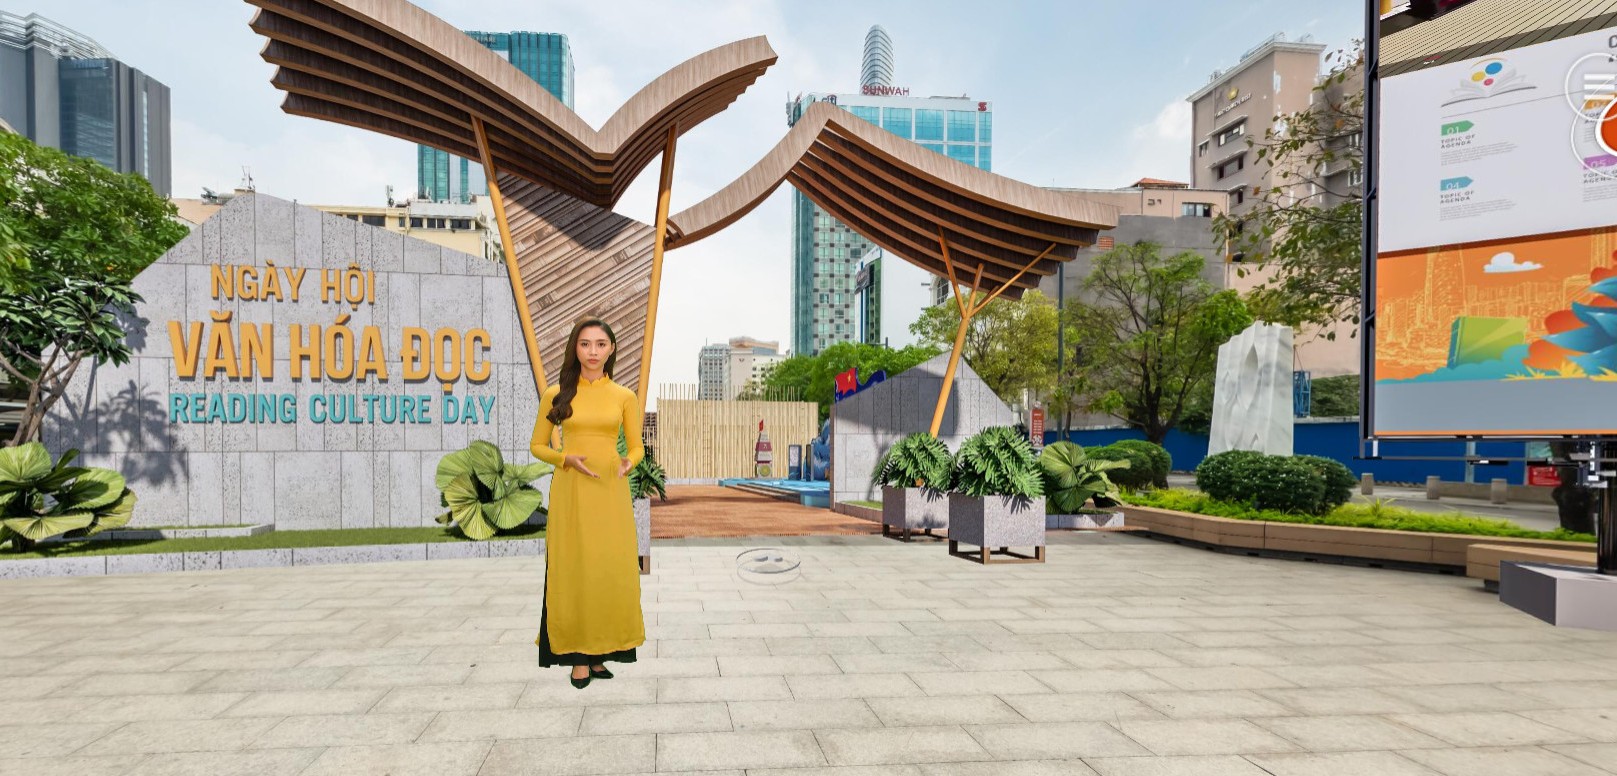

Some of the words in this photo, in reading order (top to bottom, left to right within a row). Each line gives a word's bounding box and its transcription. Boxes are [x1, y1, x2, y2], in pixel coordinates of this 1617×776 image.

[863, 84, 910, 96] SUNWAH
[1446, 126, 1460, 134] 01
[1440, 136, 1463, 144] TOPIC
[1440, 140, 1471, 149] AGENDA
[1446, 181, 1459, 190] 04
[1440, 191, 1462, 199] TOPIC
[1440, 196, 1471, 204] AGENDA
[210, 259, 307, 303] NGÀY
[320, 263, 376, 311] HỘI
[166, 309, 274, 380] VĂN
[288, 314, 389, 382] HÓA
[400, 326, 492, 394] ĐỌC
[169, 393, 298, 424] READING
[309, 394, 432, 424] CULTURE
[443, 394, 496, 425] DAY
